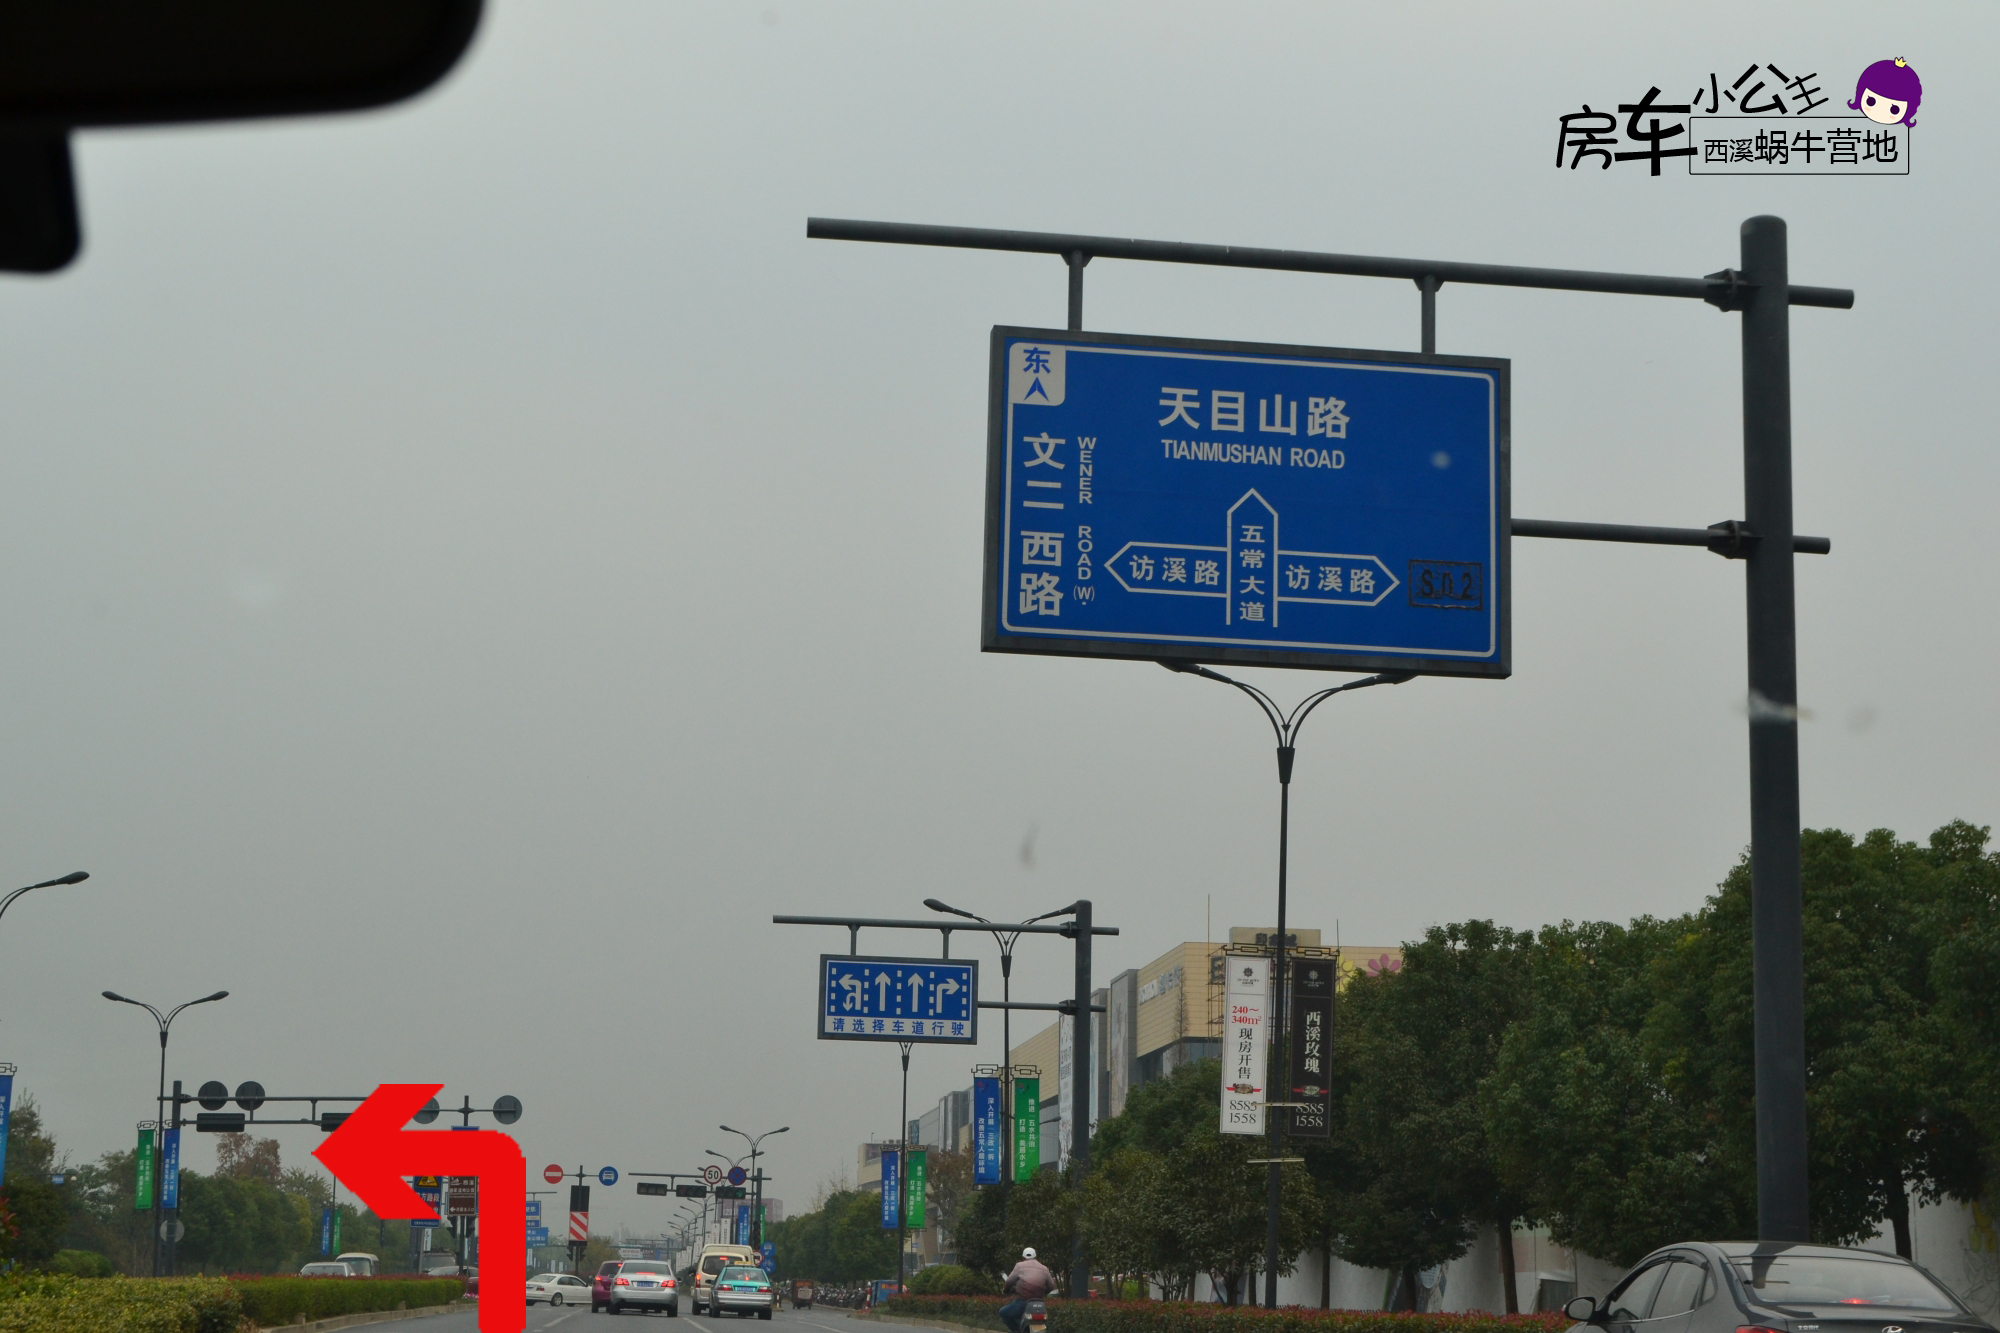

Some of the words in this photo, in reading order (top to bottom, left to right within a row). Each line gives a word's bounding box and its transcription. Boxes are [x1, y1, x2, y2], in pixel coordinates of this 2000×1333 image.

[1022, 347, 1051, 374] 东
[1158, 387, 1350, 439] 天目山路
[1161, 439, 1282, 466] TIANMUSHAN
[1290, 447, 1346, 469] ROAD
[1076, 436, 1097, 504] WENER
[1018, 432, 1066, 617] 文二西路
[1076, 525, 1093, 580] ROAD
[1129, 555, 1221, 586] 访溪路
[1239, 525, 1266, 623] 五常大道
[1285, 565, 1377, 594] 访溪路
[832, 1017, 964, 1036] 请选择车道行驶
[1237, 1027, 1253, 1080] 现房开售
[1305, 1011, 1322, 1073] 西溪玫瑰
[1229, 1100, 1257, 1111] 8585
[1229, 1113, 1257, 1124] 1558
[1295, 1102, 1324, 1114] 8585
[1295, 1115, 1323, 1127] 1558
[707, 1170, 719, 1180] 50
